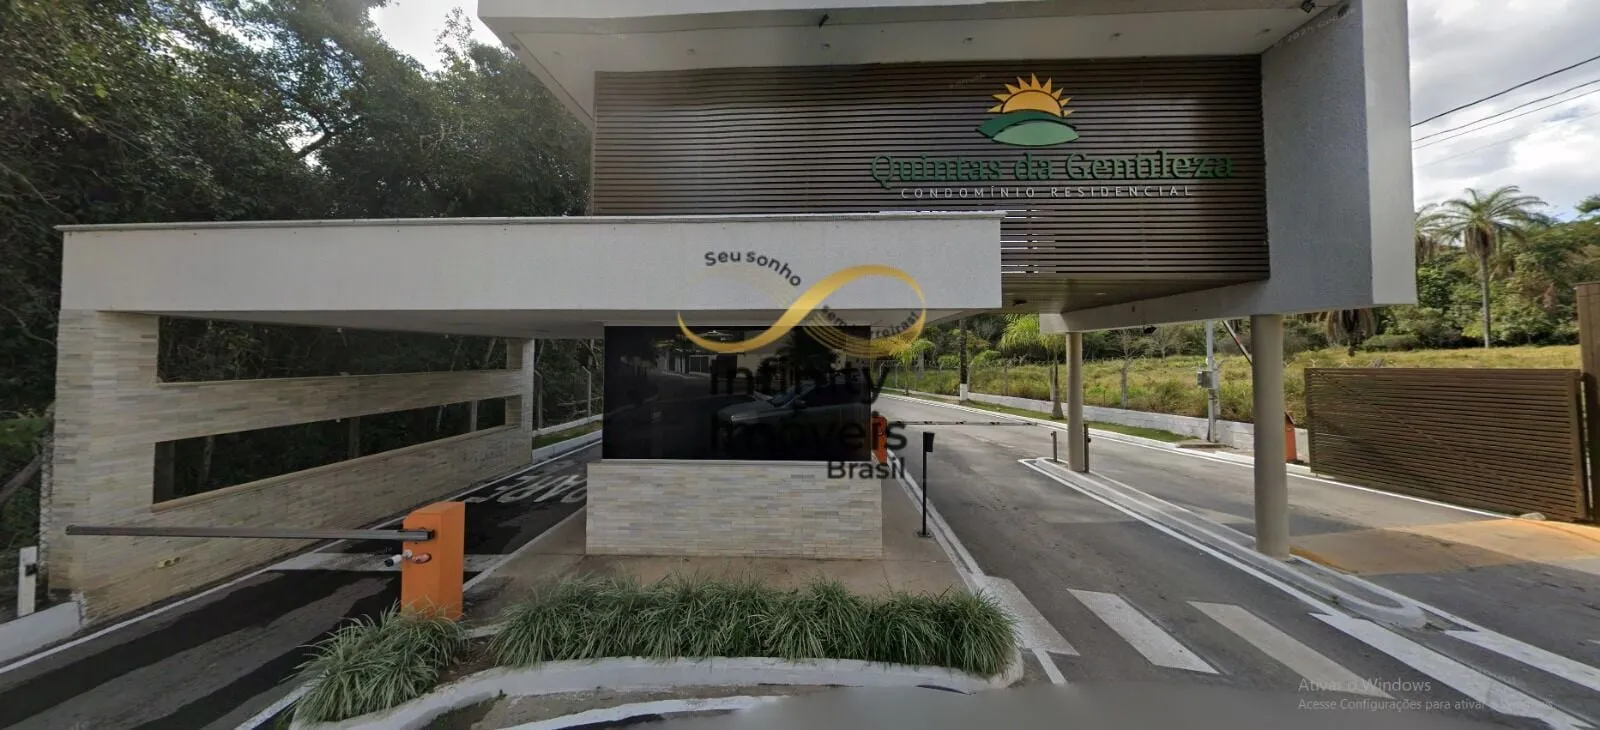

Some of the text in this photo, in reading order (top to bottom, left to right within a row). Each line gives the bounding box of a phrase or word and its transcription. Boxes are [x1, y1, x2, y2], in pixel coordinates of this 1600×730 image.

[871, 150, 1234, 190] Quintas da Gentileza
[901, 185, 1193, 199] CONDOMÍNIO RESIDENCIAL
